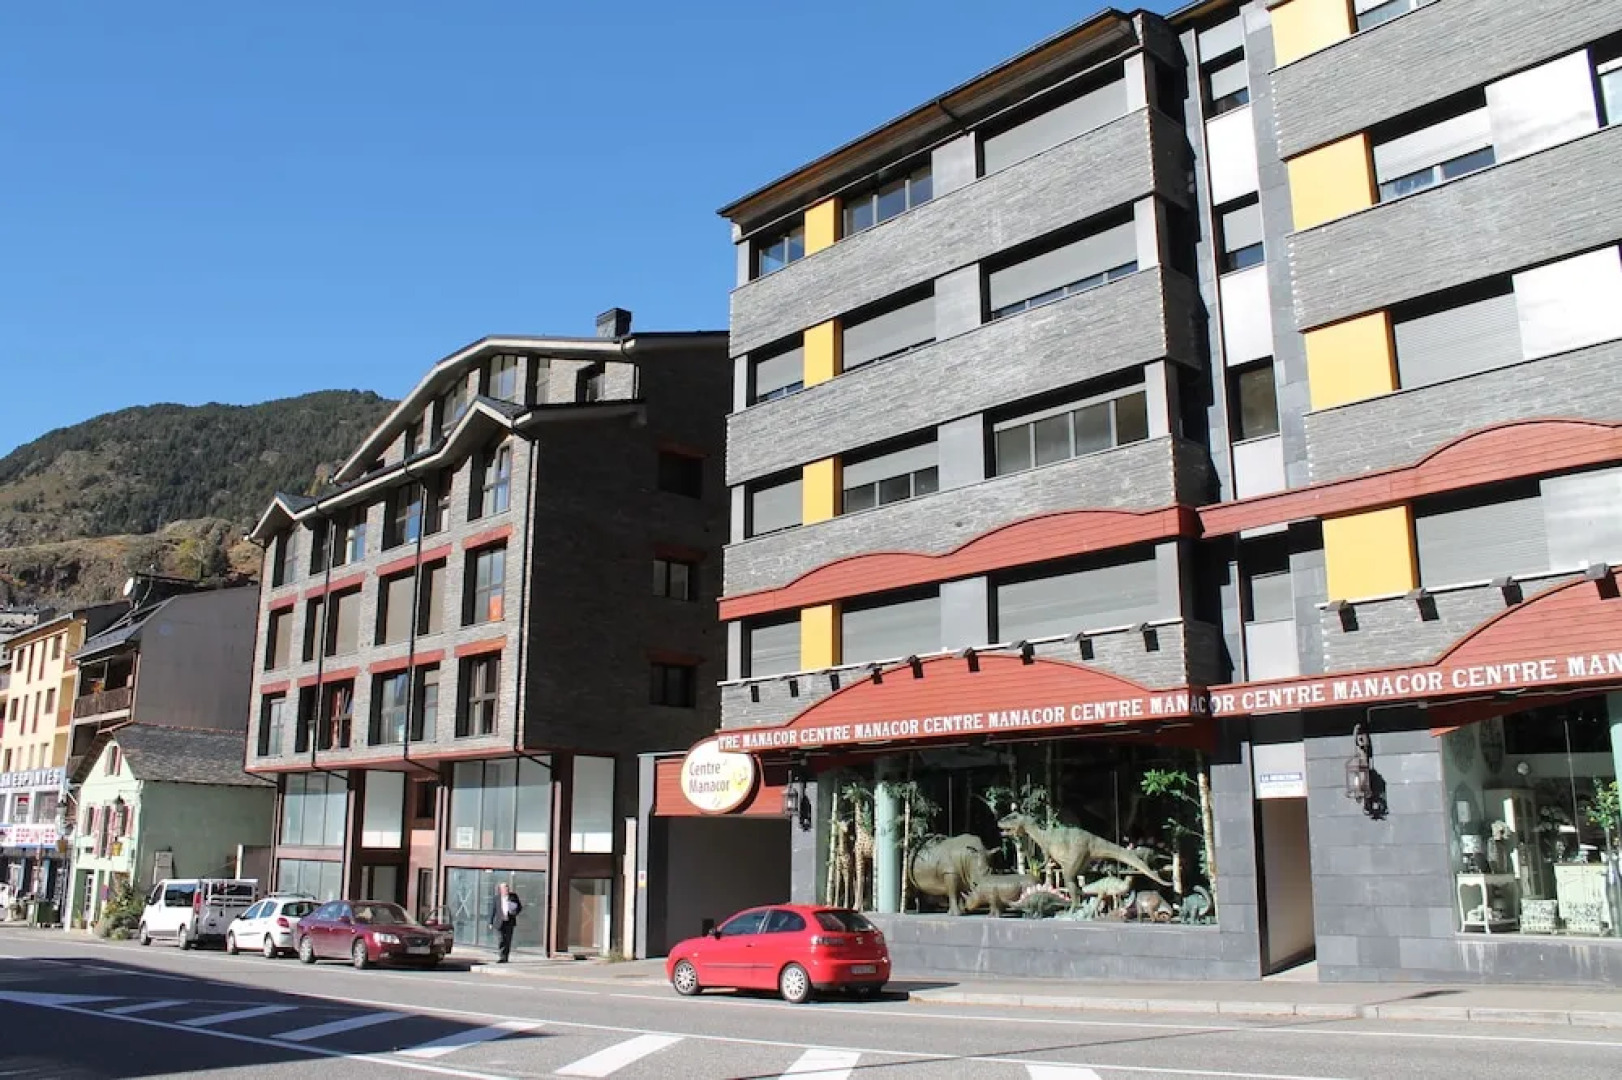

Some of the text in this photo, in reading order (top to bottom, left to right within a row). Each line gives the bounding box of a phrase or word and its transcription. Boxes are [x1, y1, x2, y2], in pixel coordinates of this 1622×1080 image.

[743, 732, 796, 748] MANACOR
[800, 725, 850, 743] CENTRE
[854, 719, 919, 739] MANACOR
[924, 713, 983, 733] CENTRE
[988, 706, 1065, 728] MANACOR
[1071, 698, 1144, 721] CENTRE
[1242, 683, 1326, 710] CENTRE
[1333, 671, 1443, 700] MANACOR
[1452, 659, 1557, 688] CENTRE
[1567, 653, 1622, 677] MAN
[689, 761, 721, 776] Centre
[689, 779, 730, 793] Manacor
